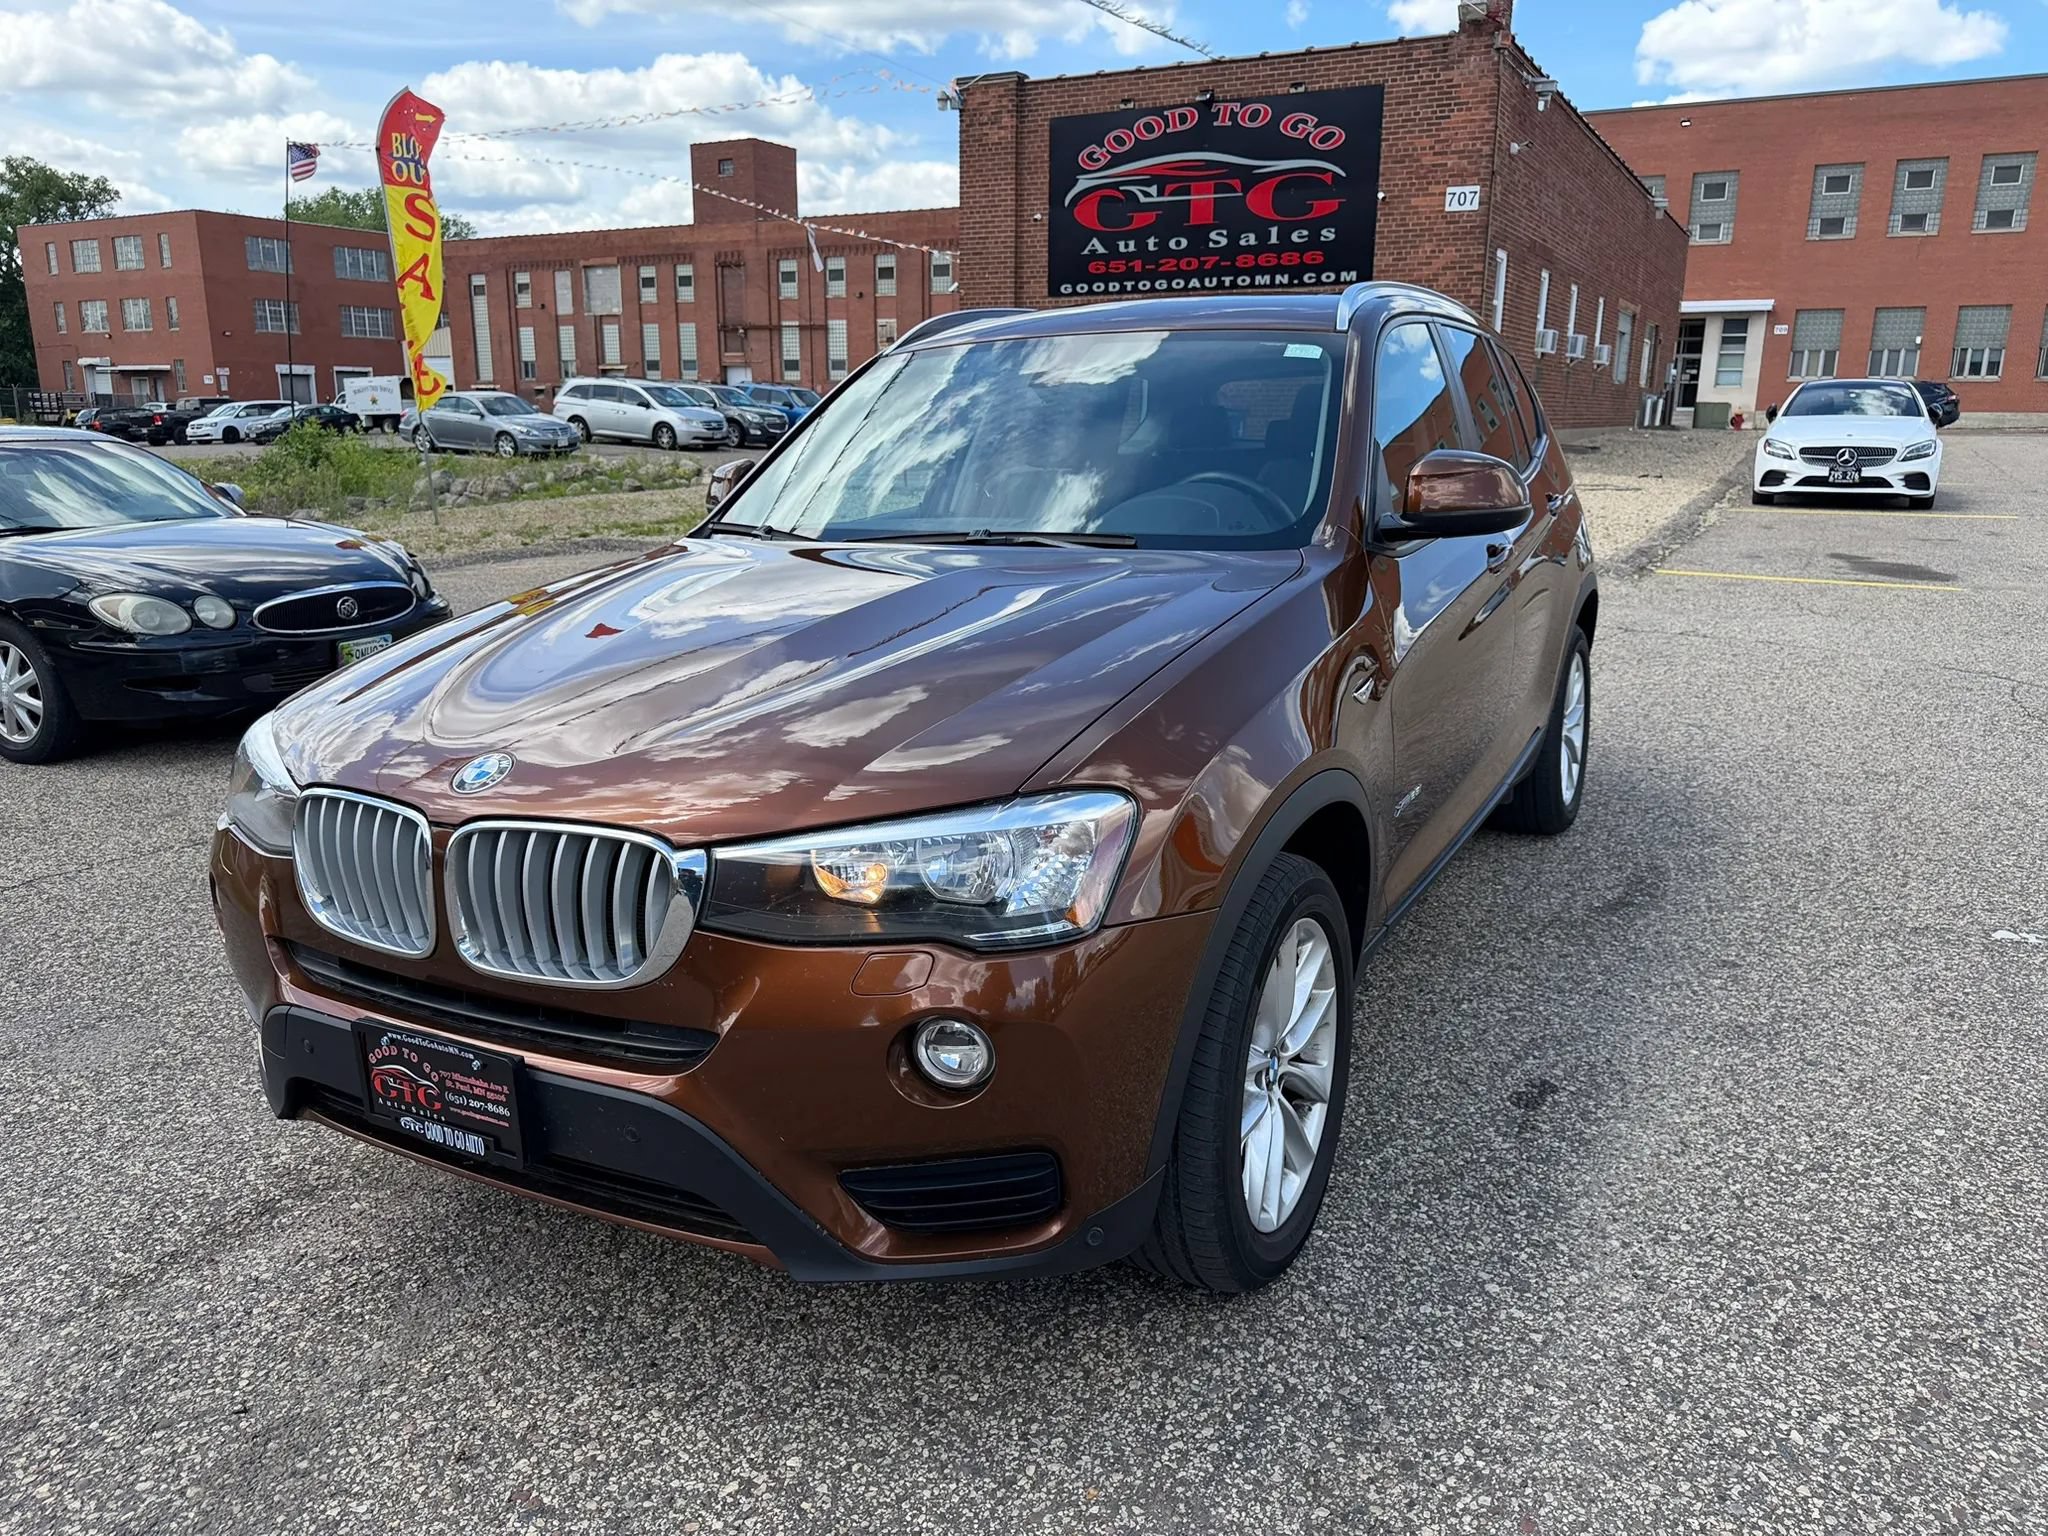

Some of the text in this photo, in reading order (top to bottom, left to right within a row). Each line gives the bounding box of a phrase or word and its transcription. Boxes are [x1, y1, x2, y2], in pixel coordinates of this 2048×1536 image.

[1078, 102, 1346, 171] GOOD TO GO
[1073, 172, 1347, 232] GTG
[1447, 191, 1478, 207] 707
[1081, 226, 1336, 255] Auto Sales
[1088, 251, 1325, 274] 651-207-8686
[1060, 271, 1358, 294] GOODTOGOAUTOMN.COM
[368, 1045, 439, 1082] GOOD TO GO
[378, 1097, 406, 1110] Auto
[411, 1106, 446, 1121] Sales
[445, 1091, 467, 1106] (651)
[468, 1099, 511, 1117] 207-8686
[424, 1121, 444, 1143] GOOD
[443, 1126, 454, 1147] TO
[454, 1130, 465, 1150] GO
[465, 1133, 485, 1156] AUTO
